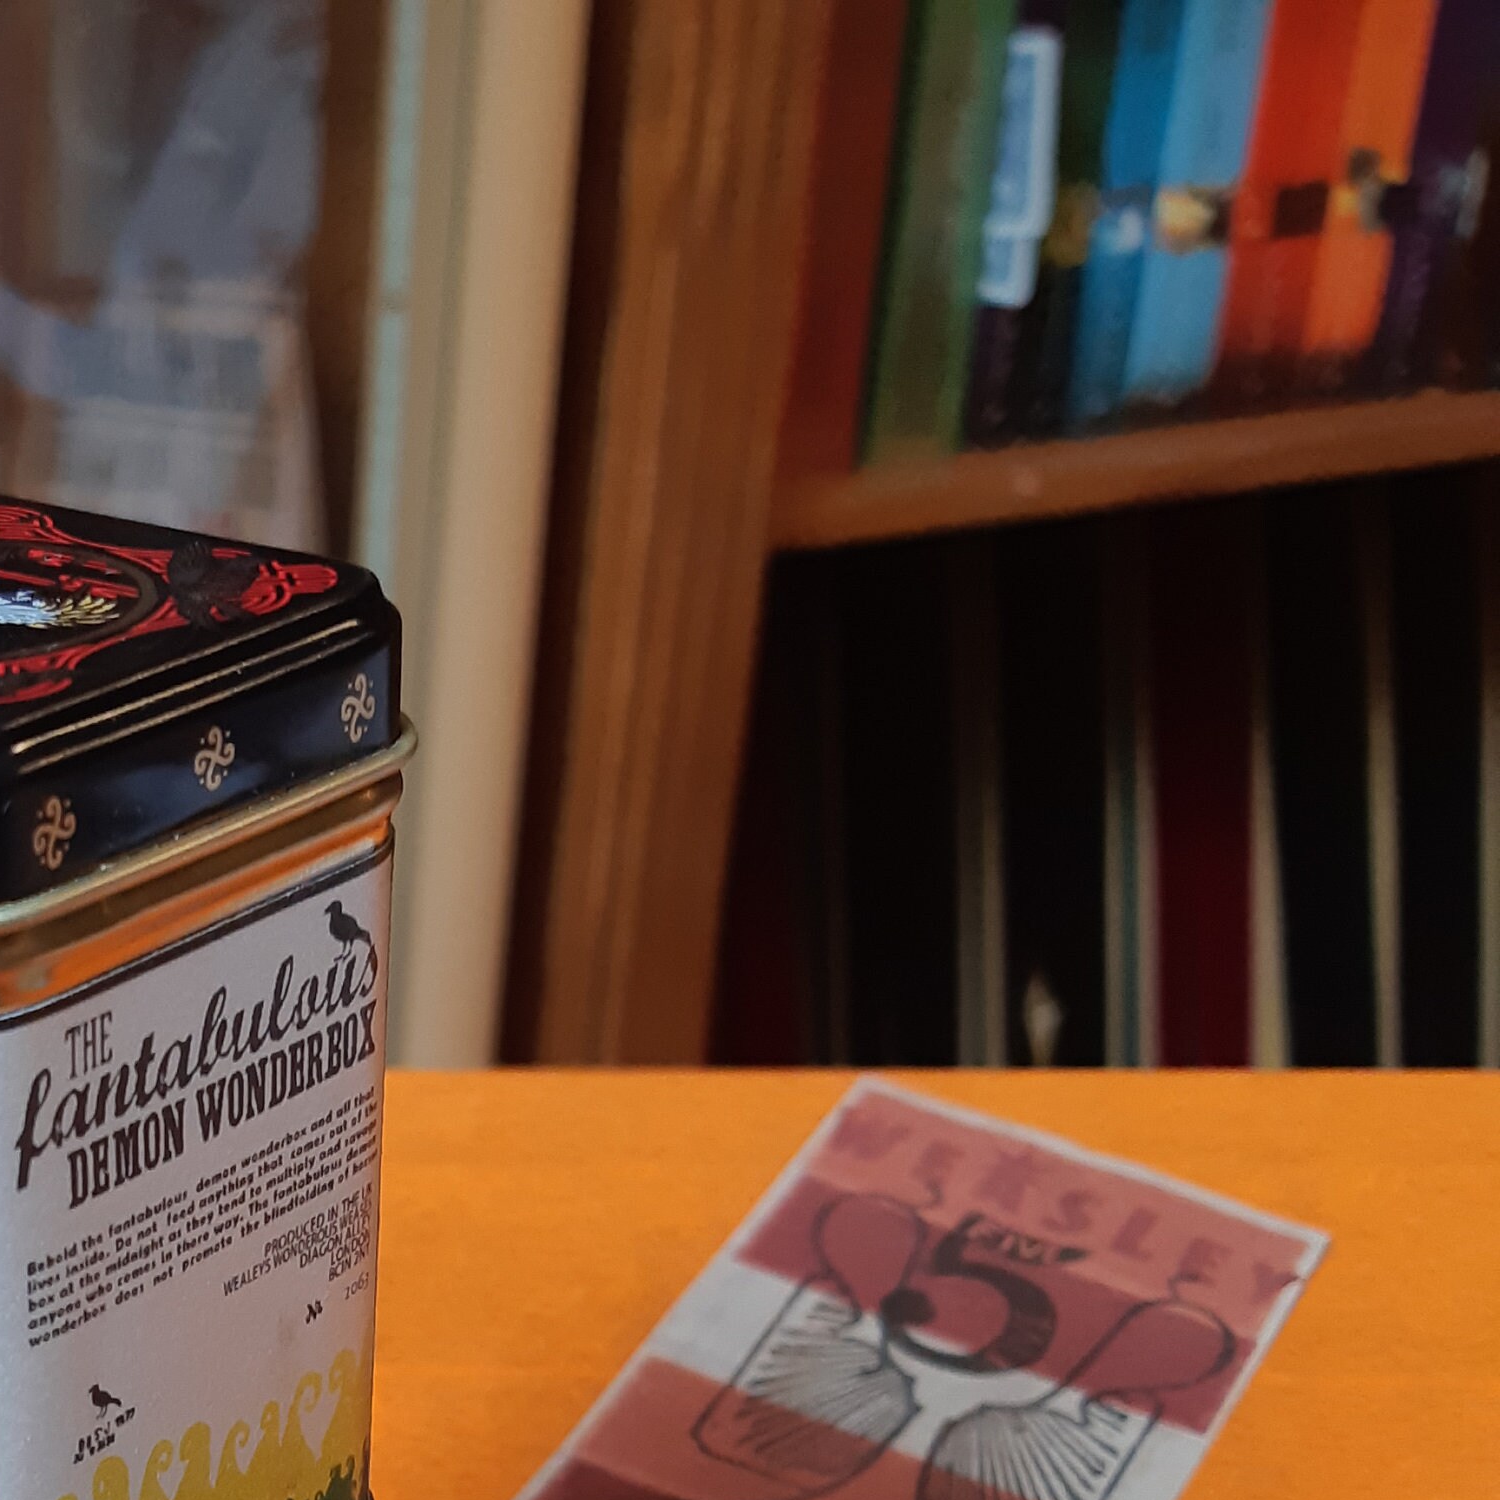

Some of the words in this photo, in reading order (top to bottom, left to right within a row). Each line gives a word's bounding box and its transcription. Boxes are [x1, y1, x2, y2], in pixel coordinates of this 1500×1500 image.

[14, 944, 379, 1193] fantabulous
[65, 1010, 114, 1081] THE
[67, 1098, 187, 1210] DEMON
[196, 1000, 377, 1142] WONDERBOX
[59, 1283, 74, 1299] at
[79, 1268, 101, 1288] the
[168, 1229, 182, 1242] as
[186, 1211, 214, 1232] they
[250, 1182, 262, 1198] to
[266, 1156, 315, 1190] multiply
[319, 1142, 341, 1162] and
[82, 1232, 103, 1252] the
[196, 1162, 237, 1193] demon
[241, 1127, 307, 1167] wonderbox
[311, 1111, 332, 1132] and
[336, 1099, 351, 1118] all
[137, 1222, 158, 1240] not
[199, 1172, 255, 1208] anything
[258, 1153, 283, 1178] that
[291, 1133, 325, 1159] comes
[329, 1120, 347, 1140] out
[351, 1111, 361, 1127] of
[248, 1200, 268, 1216] The
[264, 1212, 324, 1257] PRODUCED
[328, 1203, 339, 1222] IN
[830, 1104, 1297, 1301] WEASLEY
[153, 1266, 173, 1286] not
[241, 1220, 259, 1237] the
[300, 1234, 342, 1268] DIAGON
[881, 1211, 1088, 1375] 5
